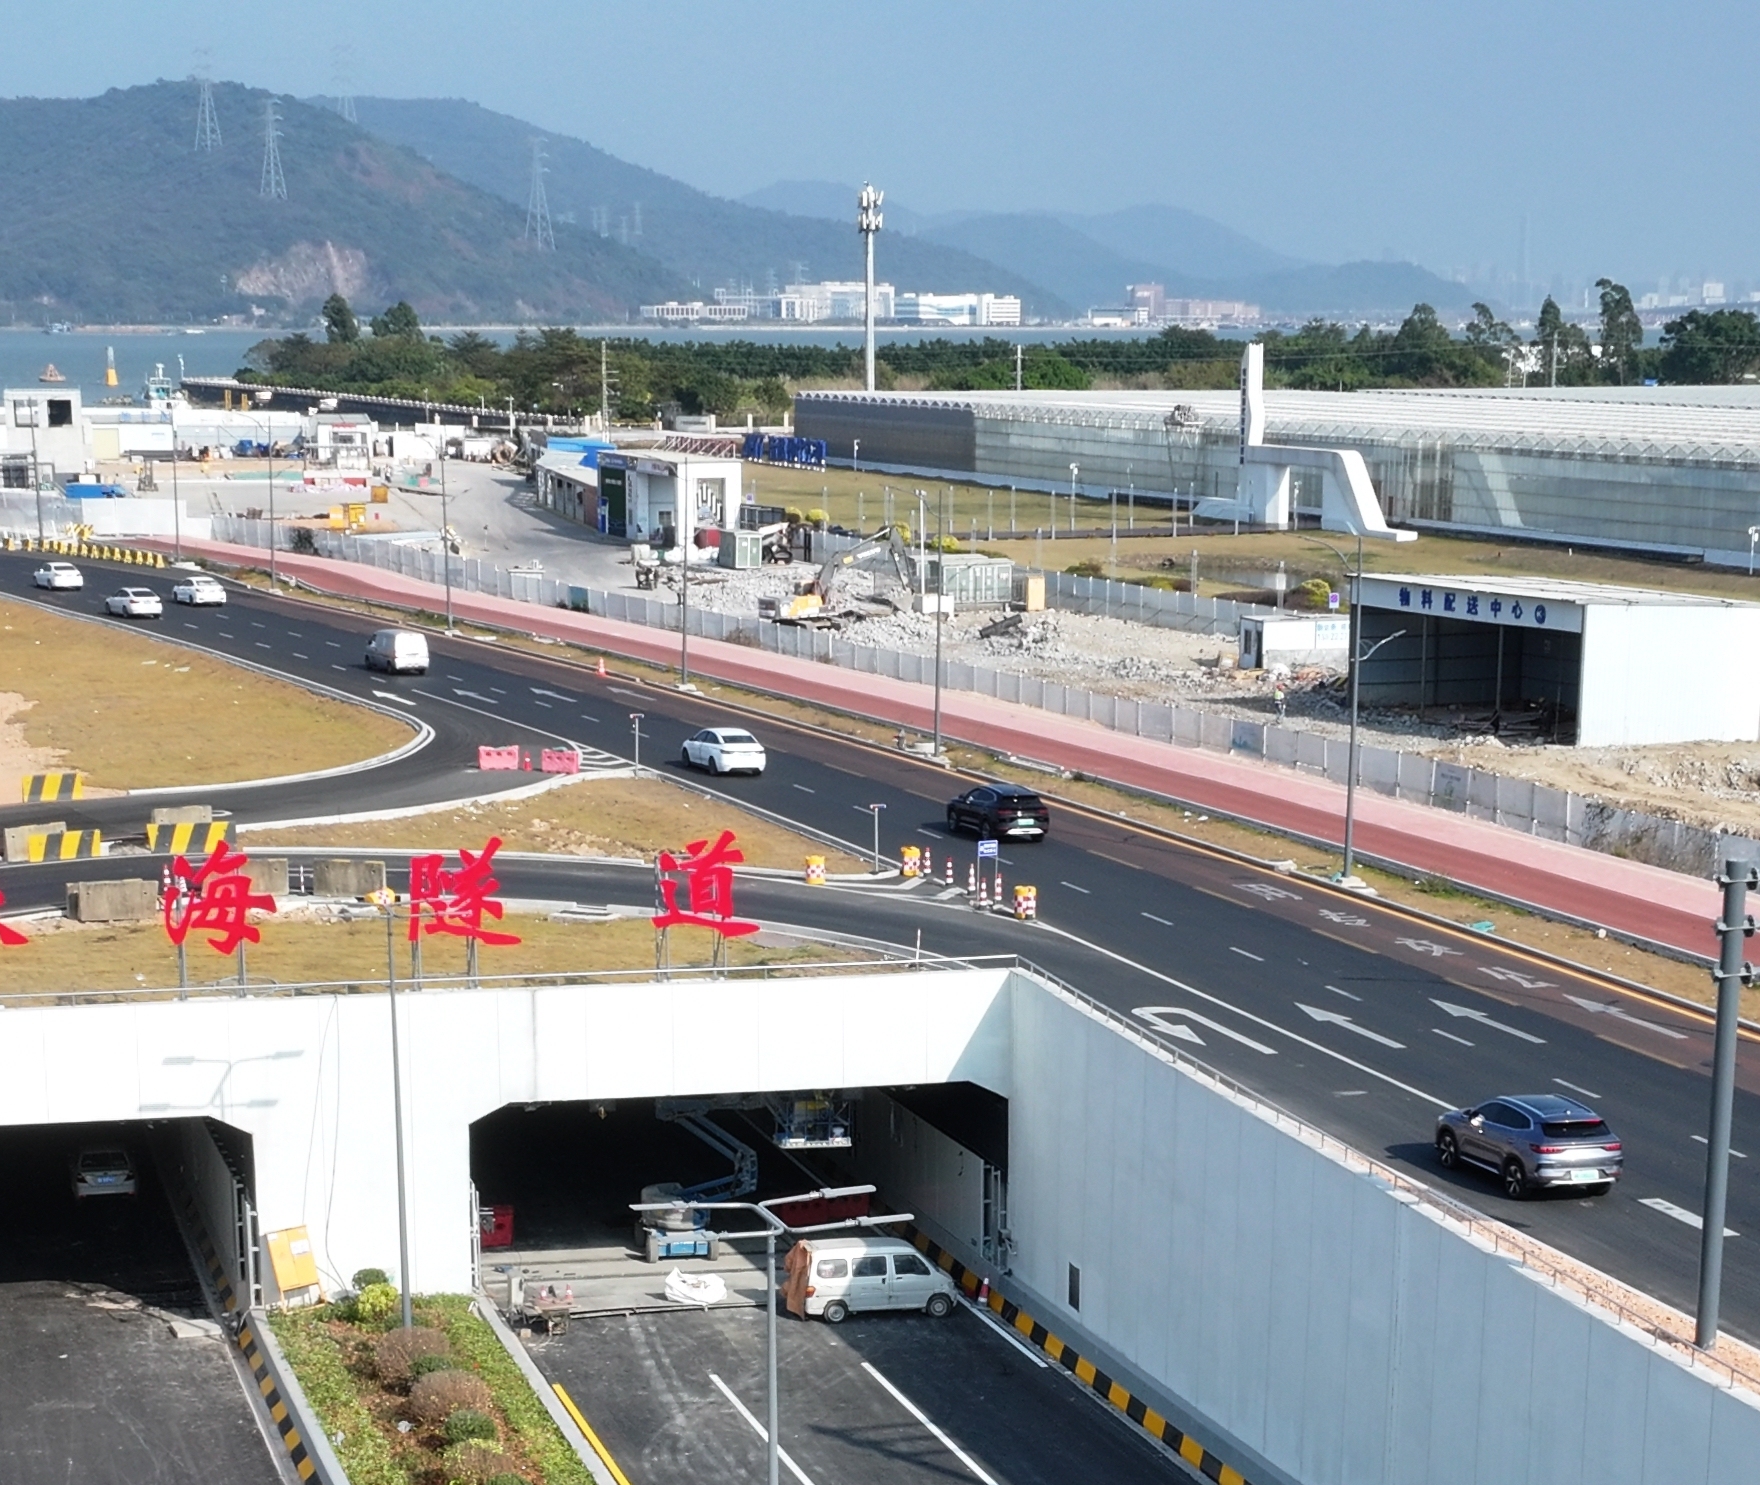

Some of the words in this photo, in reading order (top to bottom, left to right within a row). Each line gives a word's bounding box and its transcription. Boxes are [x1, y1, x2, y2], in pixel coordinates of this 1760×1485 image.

[1399, 587, 1523, 619] 物料配送中心
